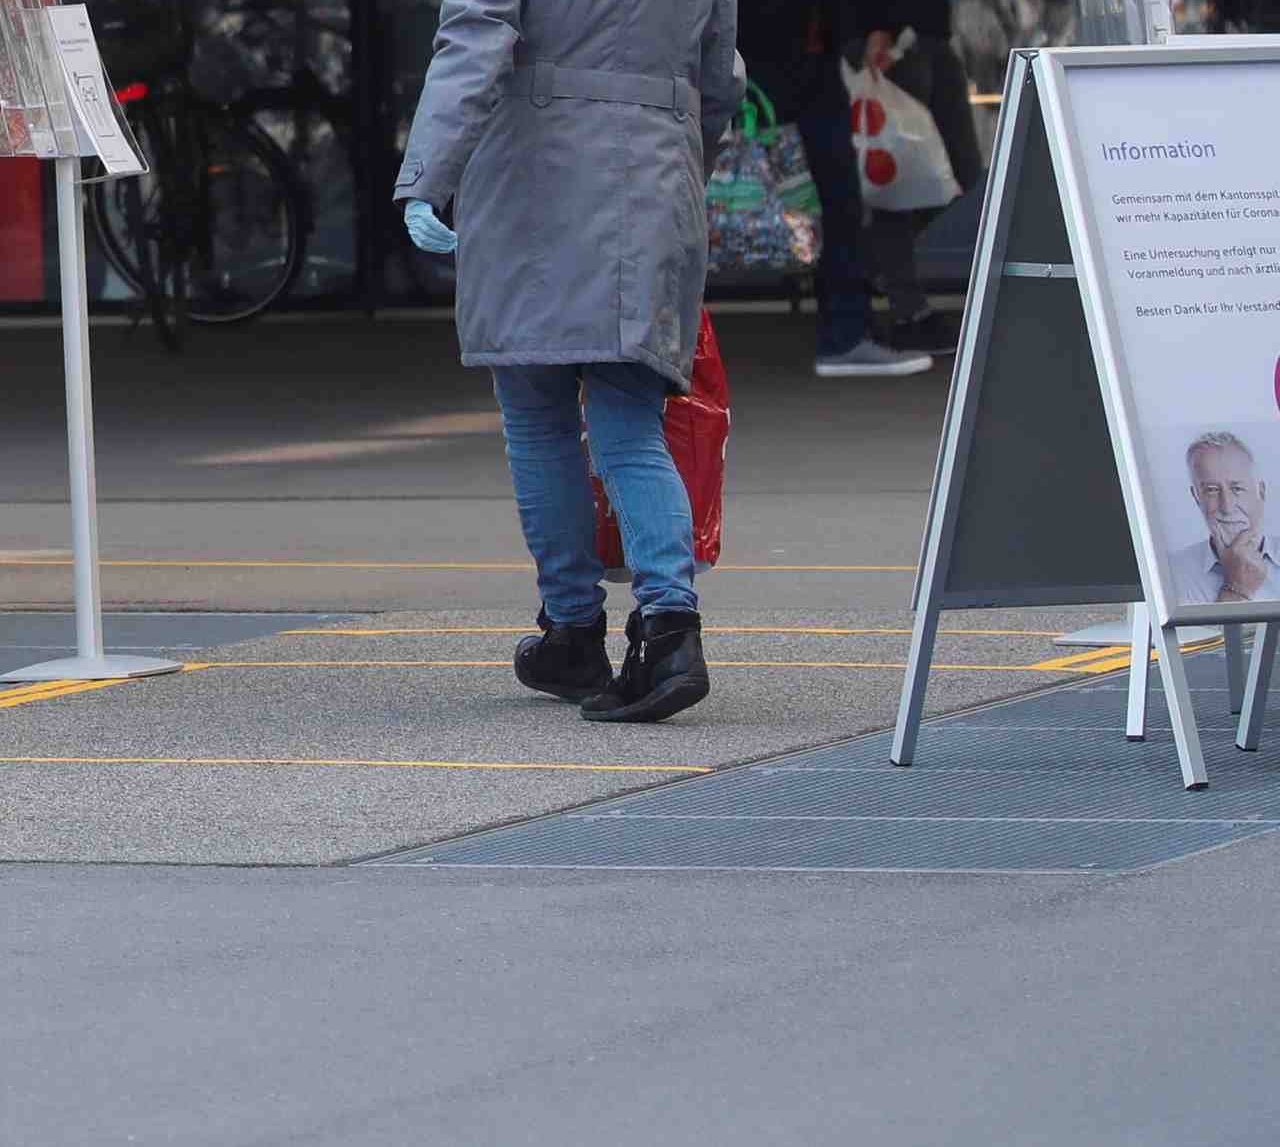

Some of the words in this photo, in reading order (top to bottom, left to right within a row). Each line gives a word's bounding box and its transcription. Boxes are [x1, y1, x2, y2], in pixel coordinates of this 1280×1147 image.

[1101, 139, 1216, 161] Information
[1112, 193, 1173, 205] Gemeinsam
[1175, 191, 1192, 202] mit
[1194, 190, 1218, 202] dem
[1116, 213, 1132, 223] wir
[1134, 211, 1161, 223] mehr
[1164, 209, 1224, 223] Kapazitäten
[1226, 208, 1240, 220] für
[1123, 250, 1147, 261] Eine
[1149, 246, 1221, 260] Untersuchung
[1222, 245, 1257, 258] erfolgt
[1259, 245, 1276, 255] nur
[1127, 266, 1204, 279] Voranmeldung
[1206, 265, 1225, 276] und
[1228, 264, 1252, 275] nach
[1136, 305, 1172, 318] Besten
[1174, 303, 1203, 315] Dank
[1203, 302, 1218, 314] für
[1220, 301, 1234, 312] Ihr
